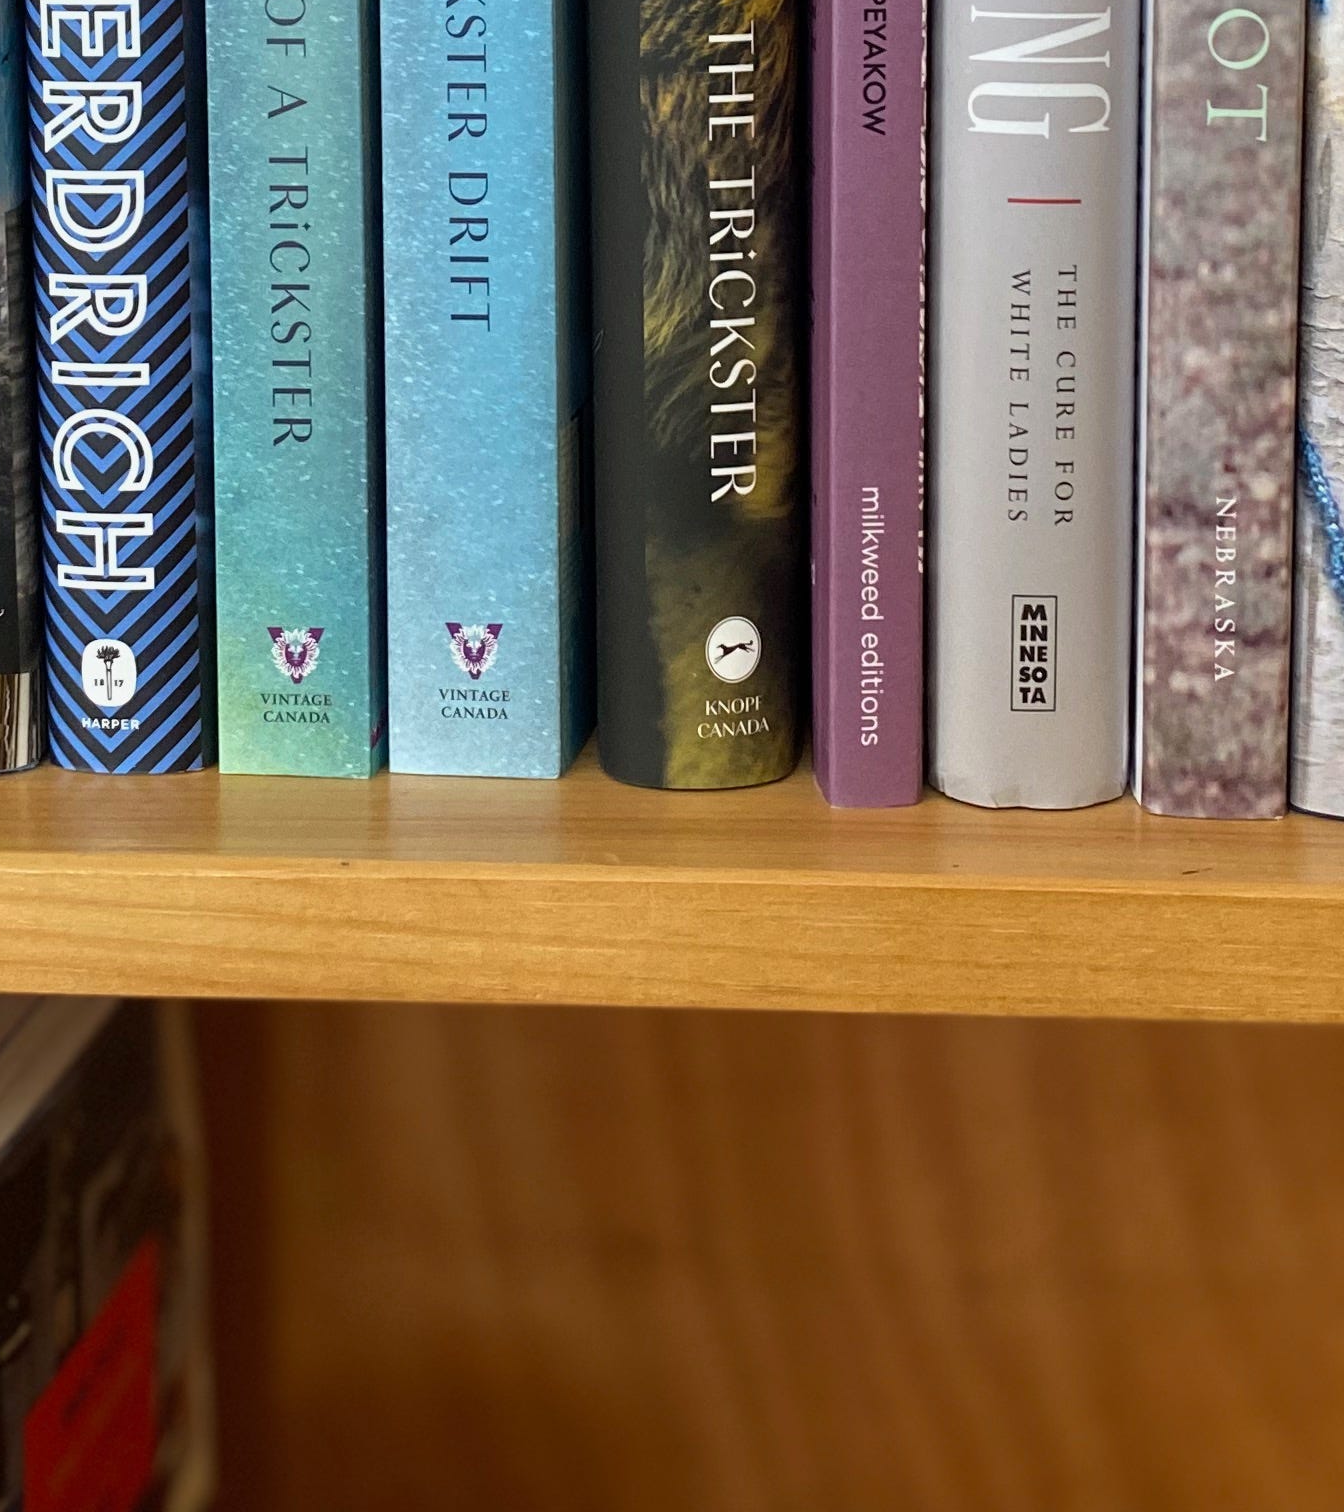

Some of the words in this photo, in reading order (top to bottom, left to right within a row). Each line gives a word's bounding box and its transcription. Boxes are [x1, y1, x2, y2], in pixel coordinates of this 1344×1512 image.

[266, 85, 308, 120] A
[707, 21, 756, 141] THE
[448, 172, 491, 332] DRIFT
[1010, 270, 1032, 383] WHITE
[1056, 264, 1077, 330] THE
[1055, 351, 1076, 442] CURE
[1008, 403, 1030, 523] LADIES
[1054, 461, 1075, 528] FOR
[861, 486, 884, 622] milkweed
[1214, 496, 1238, 682] NEBRASKA
[260, 694, 332, 707] VINTAGE
[263, 711, 331, 725] CANADA
[438, 689, 511, 702] VINTAGE
[440, 706, 508, 721] CANADA
[705, 697, 763, 716] KNOPF
[860, 634, 880, 746] editions
[81, 717, 140, 731] HARPER
[696, 718, 770, 739] CANADA
